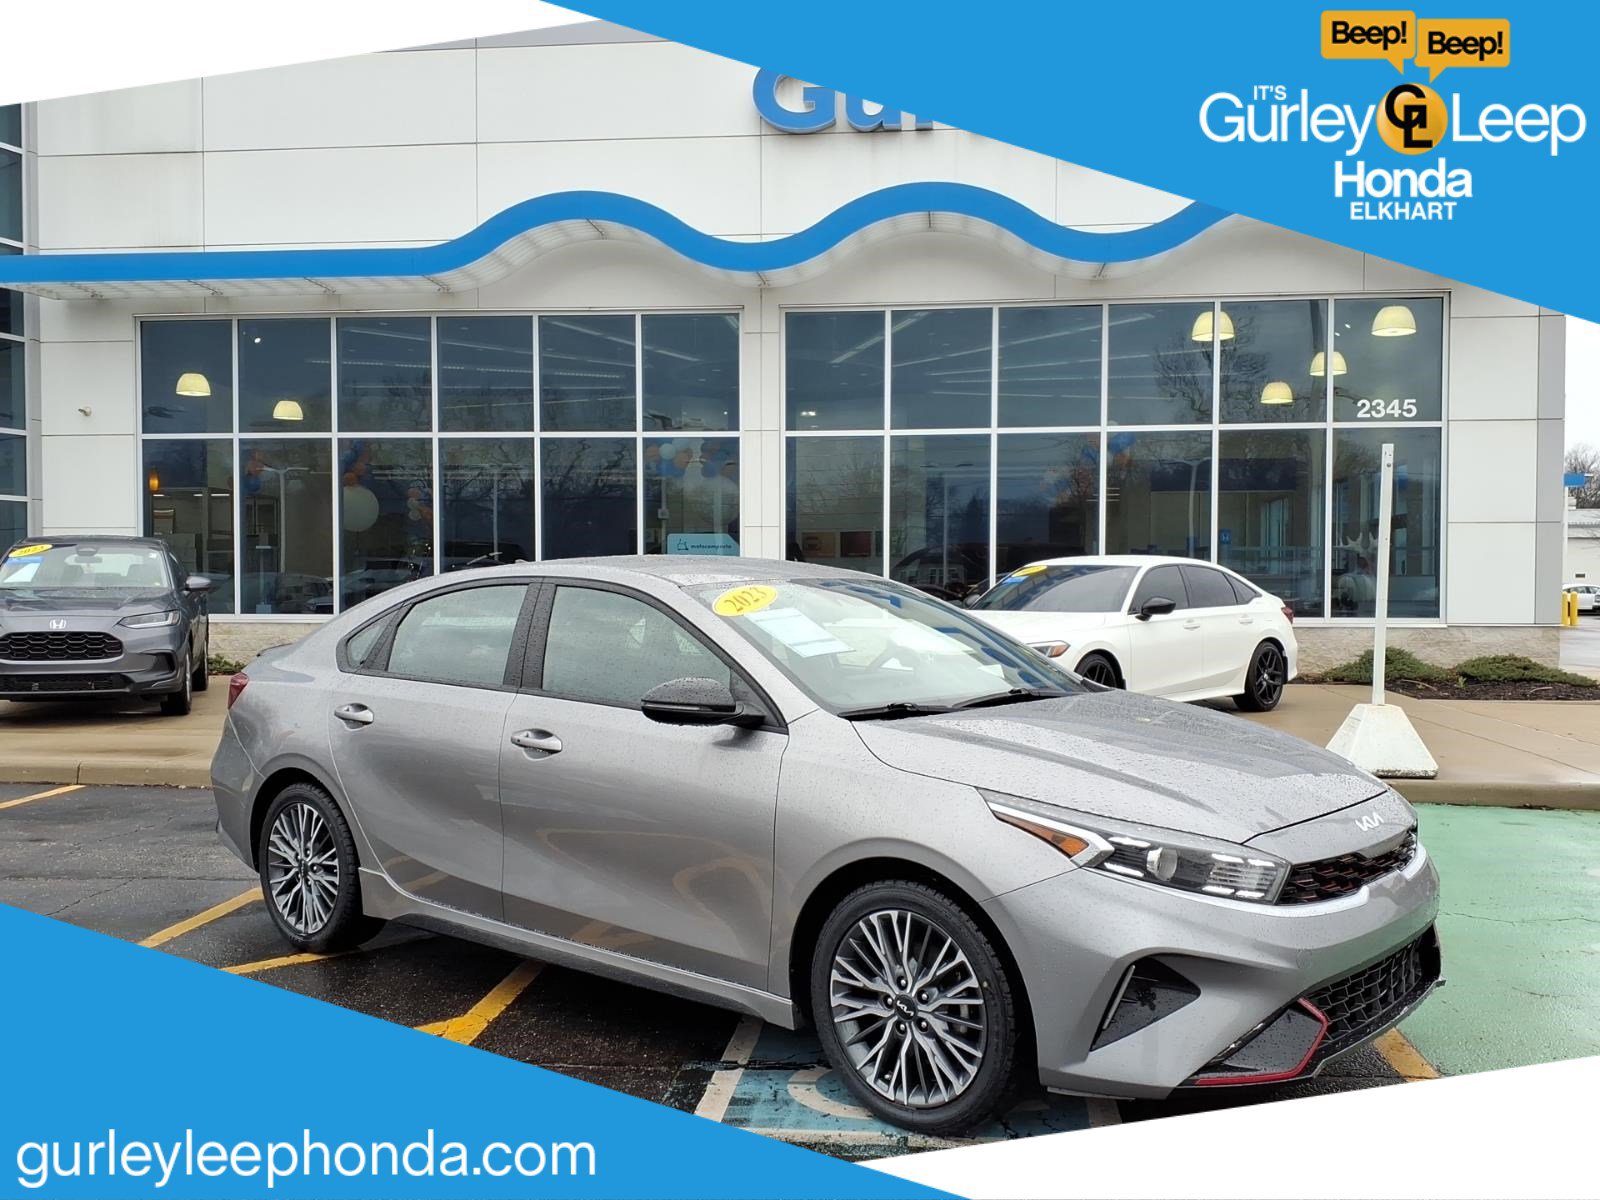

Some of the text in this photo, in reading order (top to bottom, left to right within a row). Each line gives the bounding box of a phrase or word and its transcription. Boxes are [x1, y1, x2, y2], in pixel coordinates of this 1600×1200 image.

[752, 67, 933, 133] Gu
[1356, 399, 1417, 418] 2345
[724, 586, 767, 612] 2023
